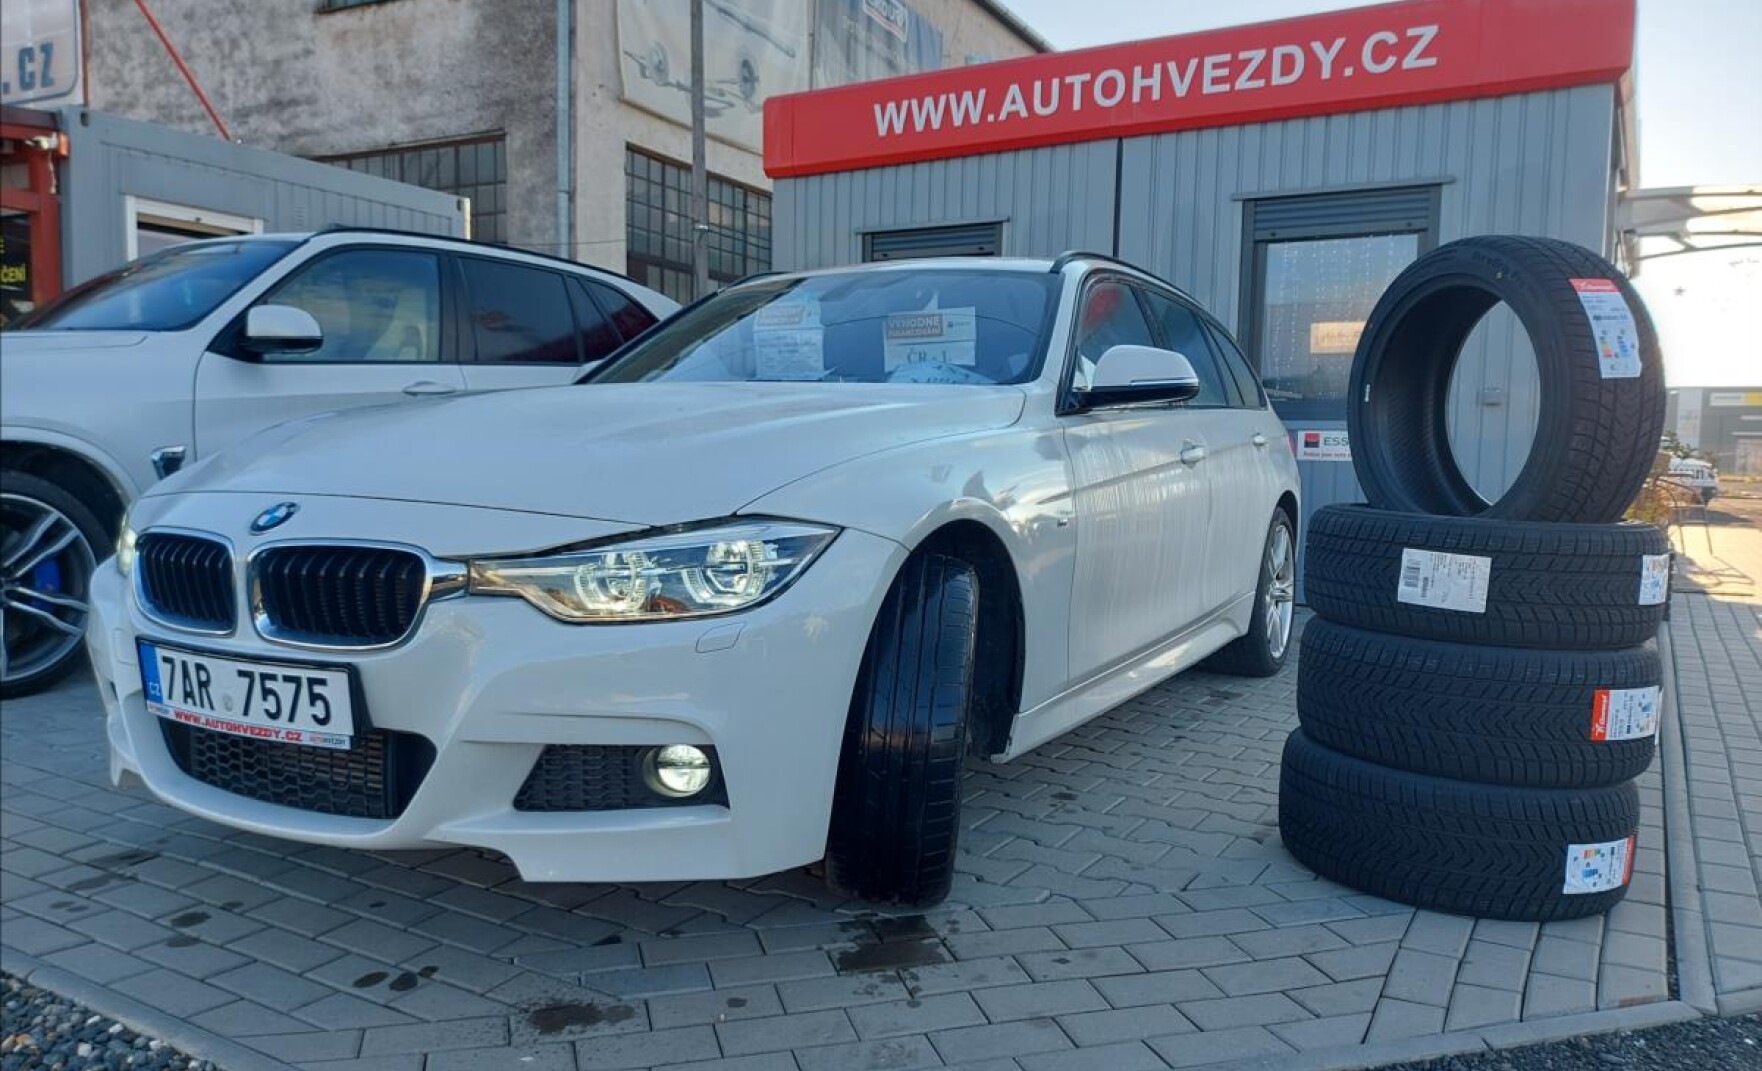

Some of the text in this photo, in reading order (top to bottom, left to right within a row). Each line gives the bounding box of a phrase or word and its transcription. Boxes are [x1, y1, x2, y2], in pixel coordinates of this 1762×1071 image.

[874, 25, 1438, 136] WWW.AUTOHVEZDY.CZ
[162, 655, 331, 726] 7AR 7575
